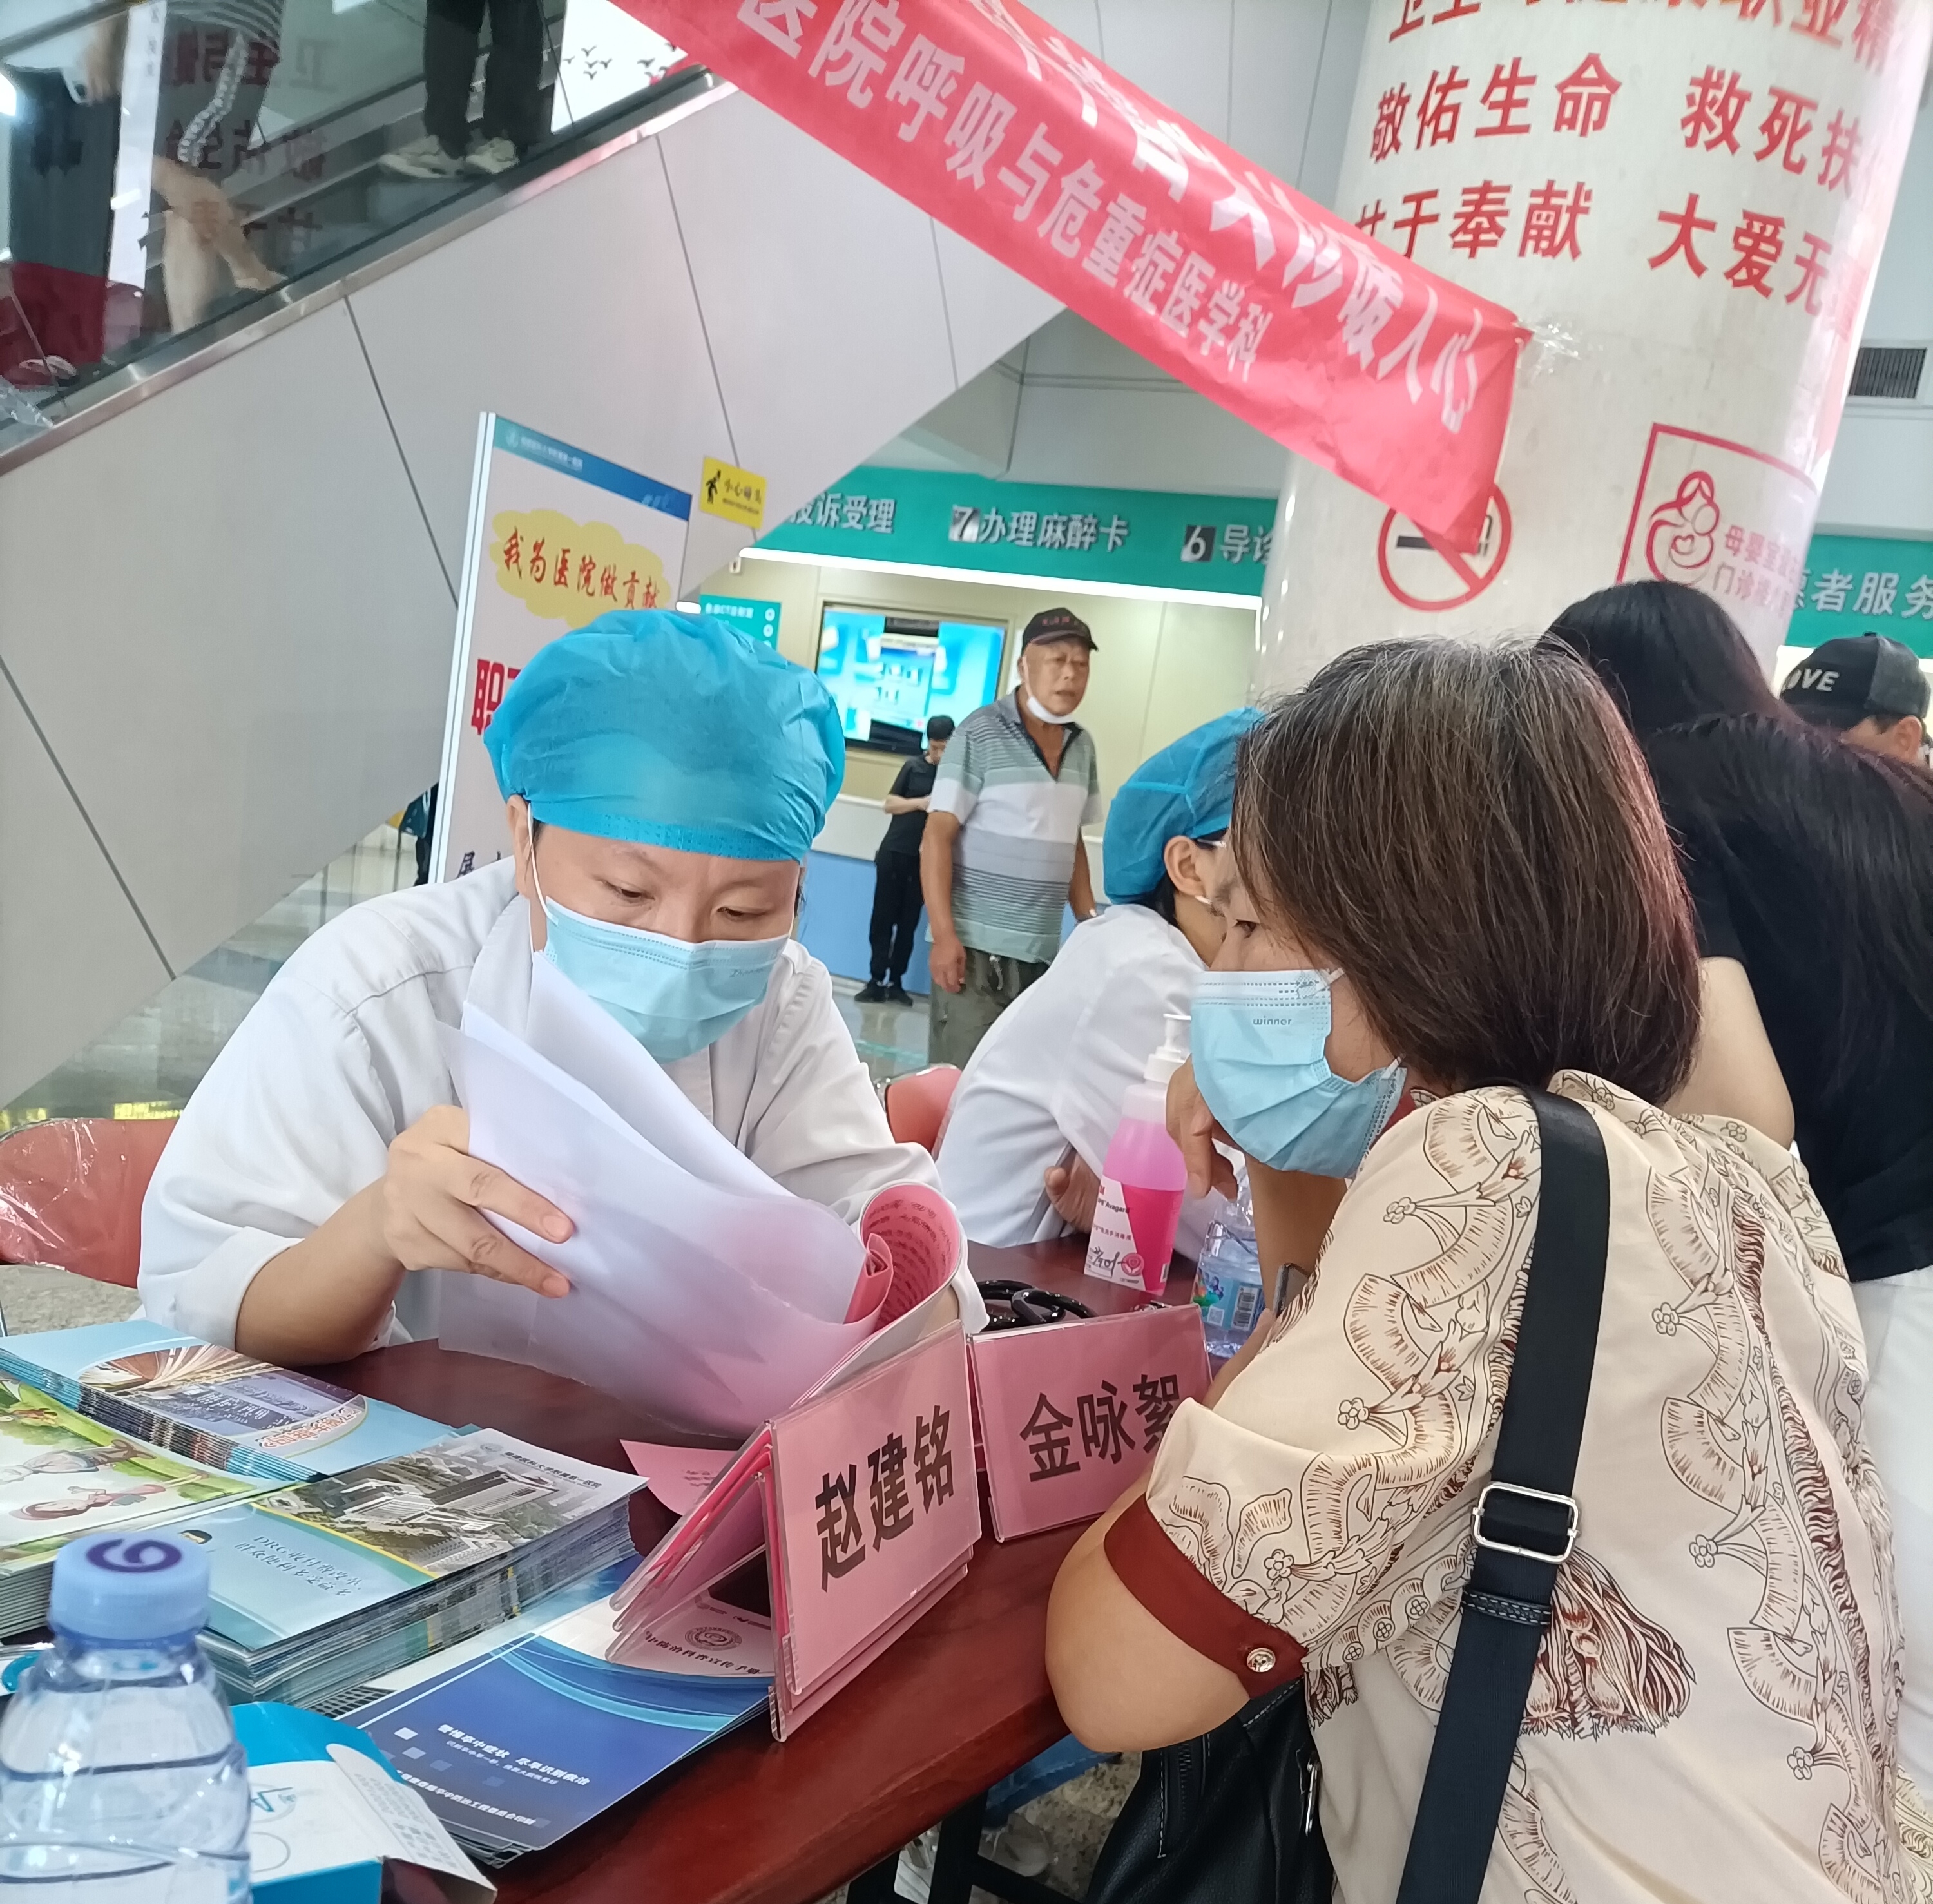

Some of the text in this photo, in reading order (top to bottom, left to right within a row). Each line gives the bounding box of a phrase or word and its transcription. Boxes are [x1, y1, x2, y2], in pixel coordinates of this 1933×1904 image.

[1370, 52, 1622, 164] 敬佑生命
[736, 0, 1273, 383] 医院呼吸与危重症医学科
[1648, 193, 1864, 341] 大爱无
[503, 526, 660, 610] 我为医院做贡献
[949, 505, 1129, 553] 7 办理麻醉卡
[1184, 525, 1210, 562] 6
[470, 658, 521, 735] 职
[1781, 668, 1840, 691] OVE
[1252, 1016, 1293, 1026] winner
[1019, 1374, 1181, 1483] 金咏絮
[815, 1405, 955, 1593] 赵建铭
[645, 1630, 760, 1675] 中防治科普宣传手册
